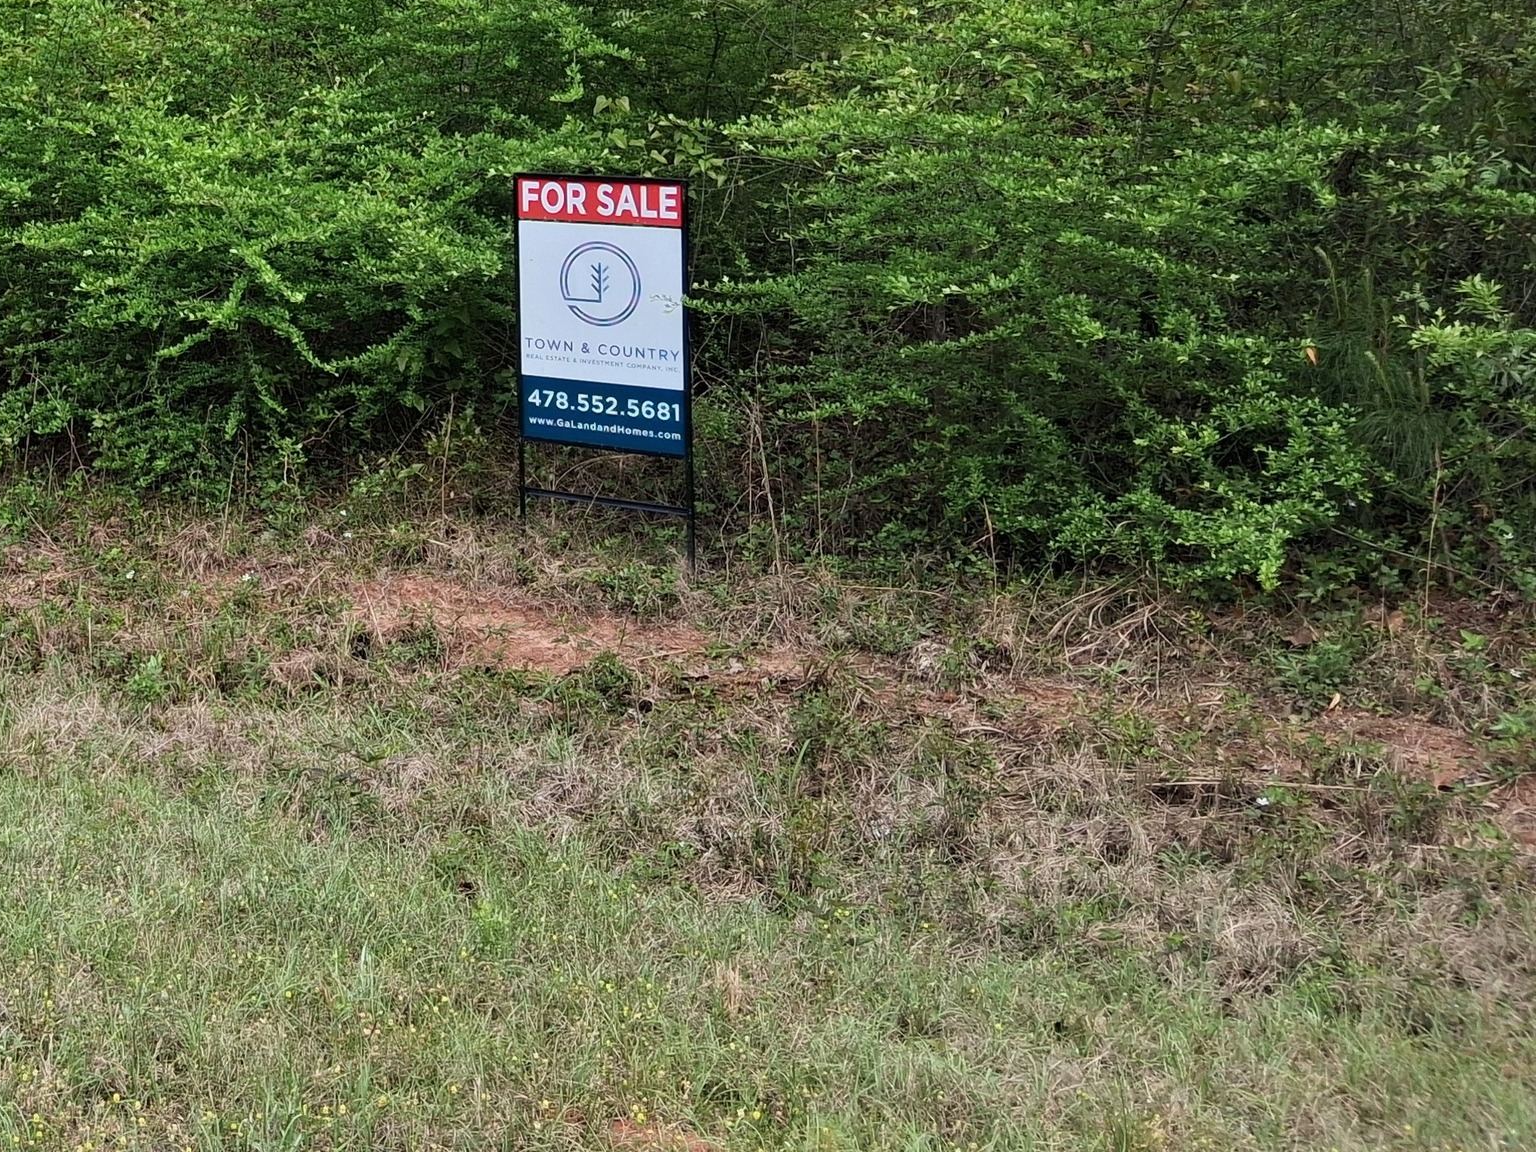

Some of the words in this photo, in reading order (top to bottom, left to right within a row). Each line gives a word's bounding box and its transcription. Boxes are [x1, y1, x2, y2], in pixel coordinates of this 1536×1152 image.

[521, 180, 587, 215] FOR
[596, 183, 679, 219] SALE
[525, 337, 574, 352] TOWN
[581, 342, 591, 354] &
[597, 343, 680, 362] COUNTRY
[545, 354, 570, 362] ESTATE
[579, 358, 624, 367] INVESTMENT
[626, 362, 663, 372] COMPANY,
[528, 389, 681, 422] 478.552.5681
[528, 415, 681, 441] www.GaLandandHomes.com
